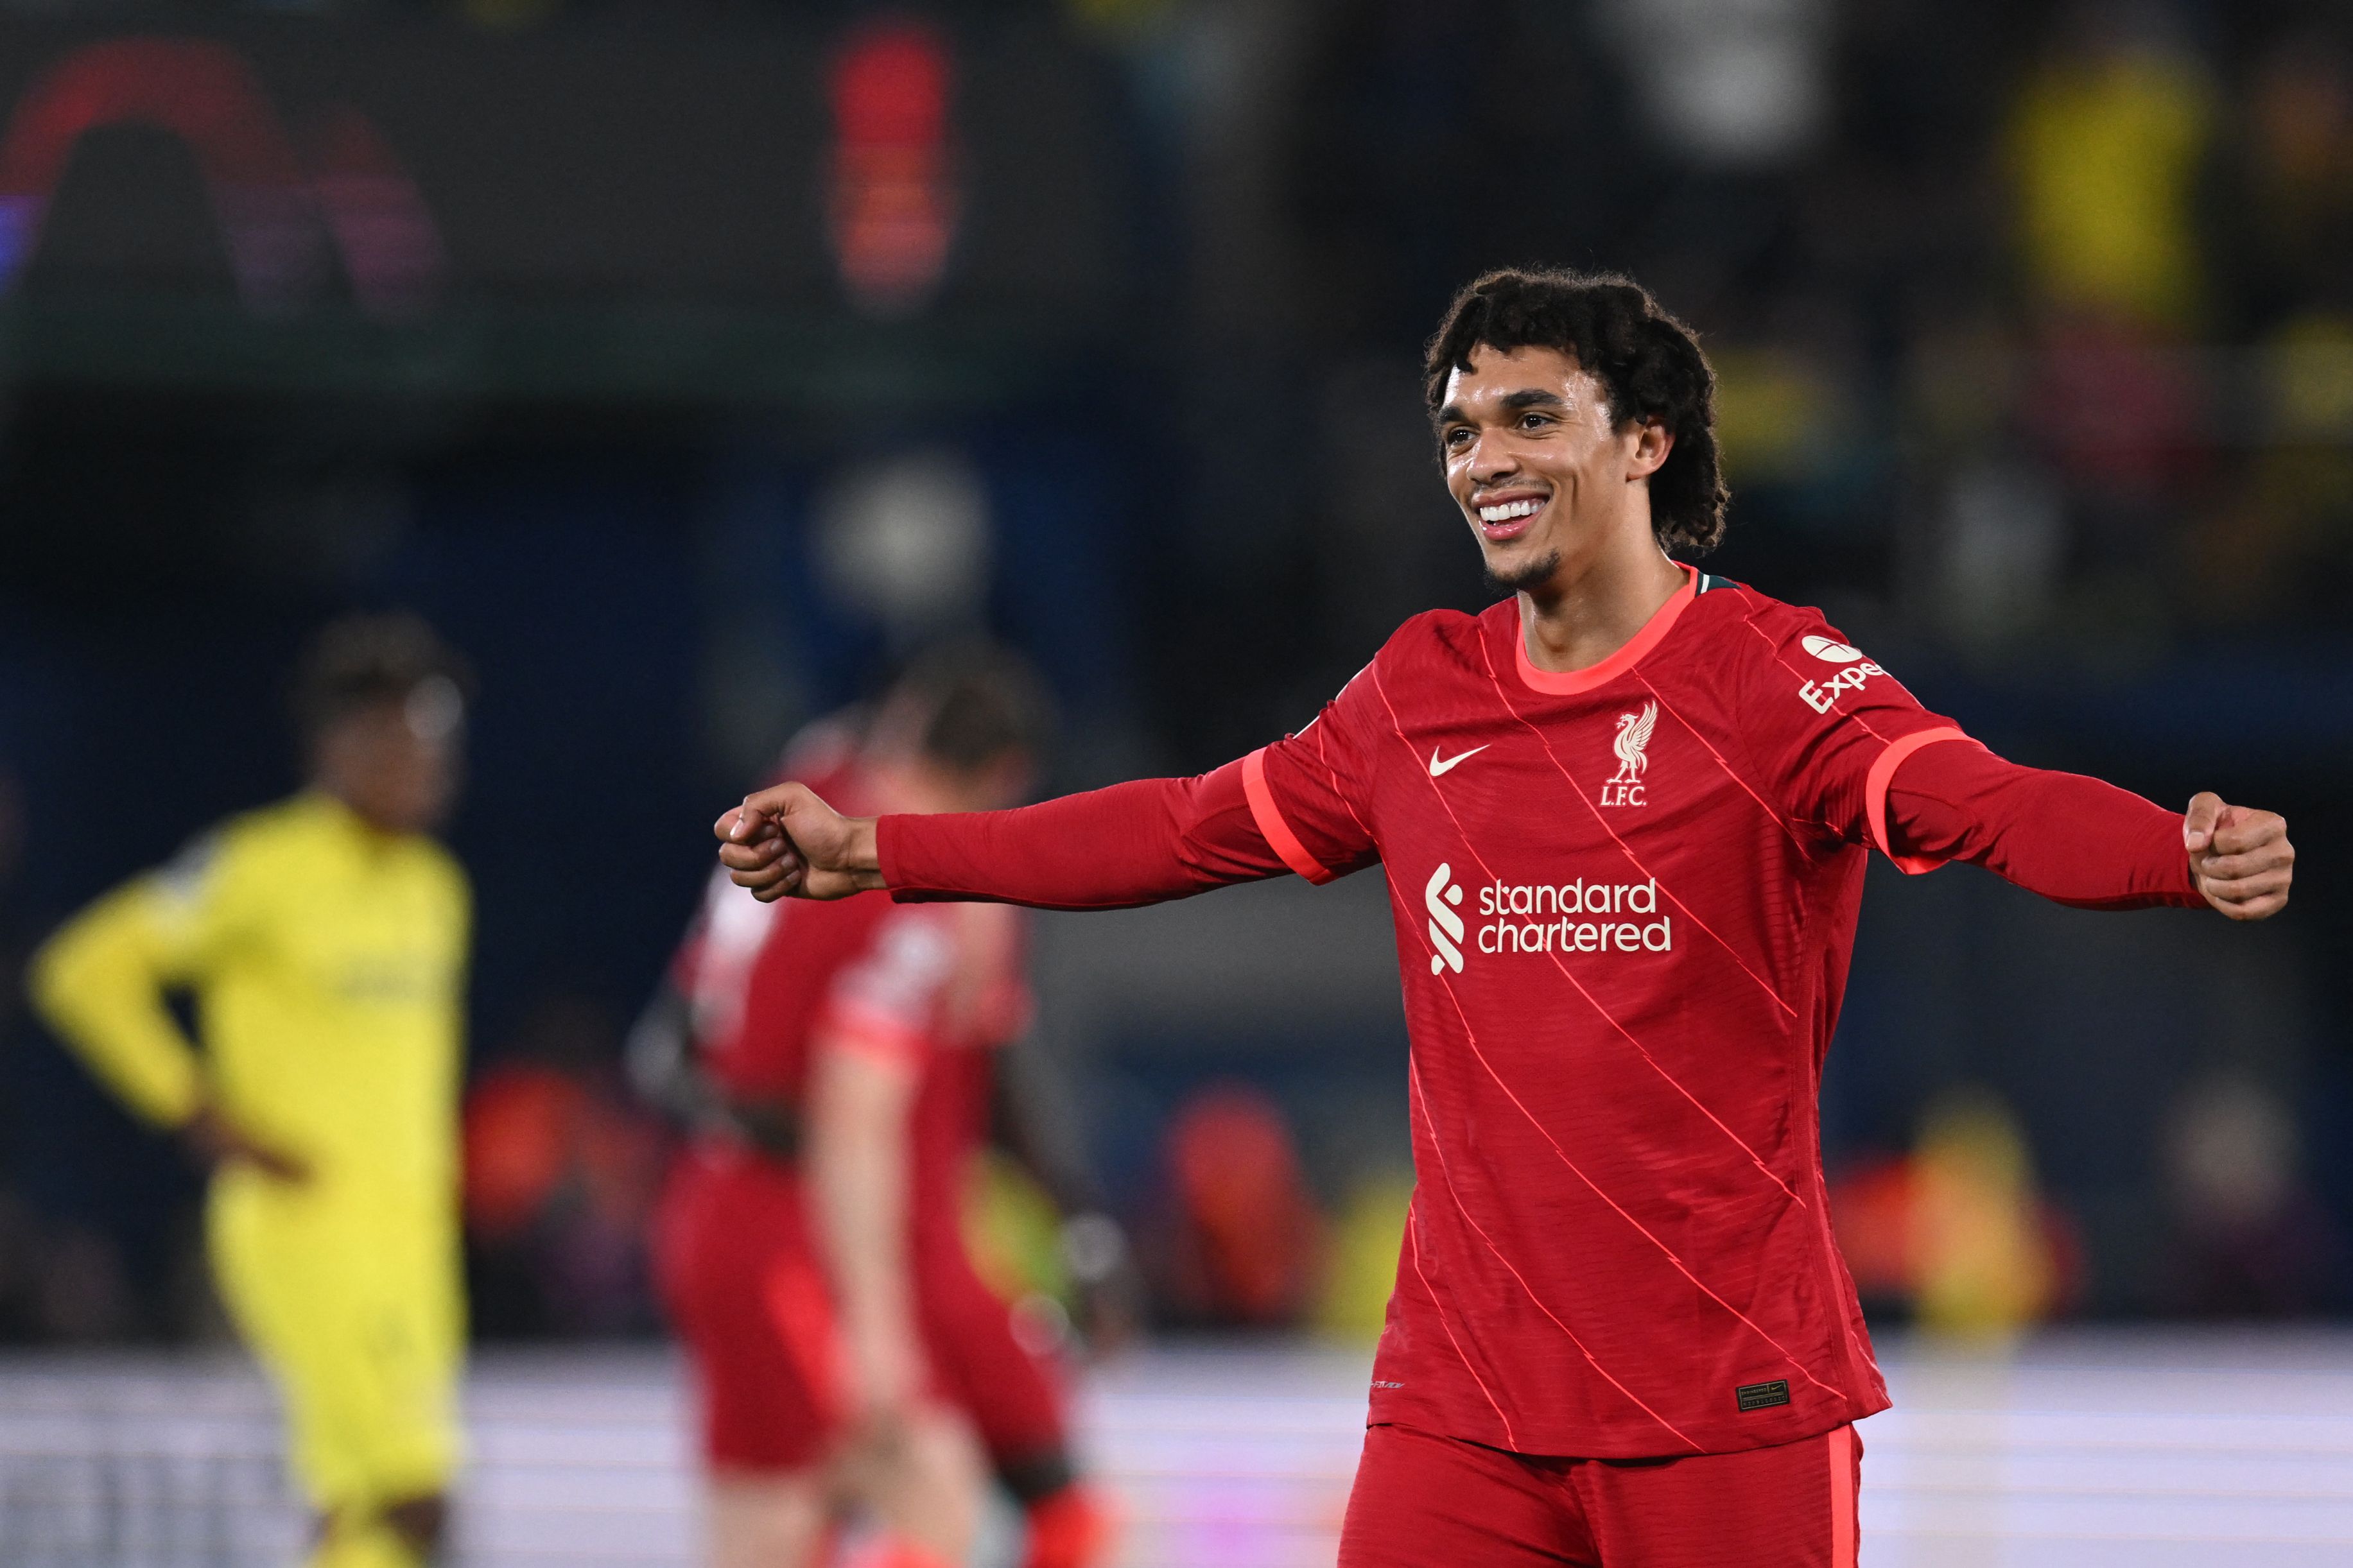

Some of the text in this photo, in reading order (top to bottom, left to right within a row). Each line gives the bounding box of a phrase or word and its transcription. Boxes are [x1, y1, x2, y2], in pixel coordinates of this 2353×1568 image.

[1798, 662, 1891, 714] Expe
[1601, 786, 1647, 806] L.F.C.
[1479, 877, 1656, 915] standard
[1478, 915, 1671, 954] chartered
